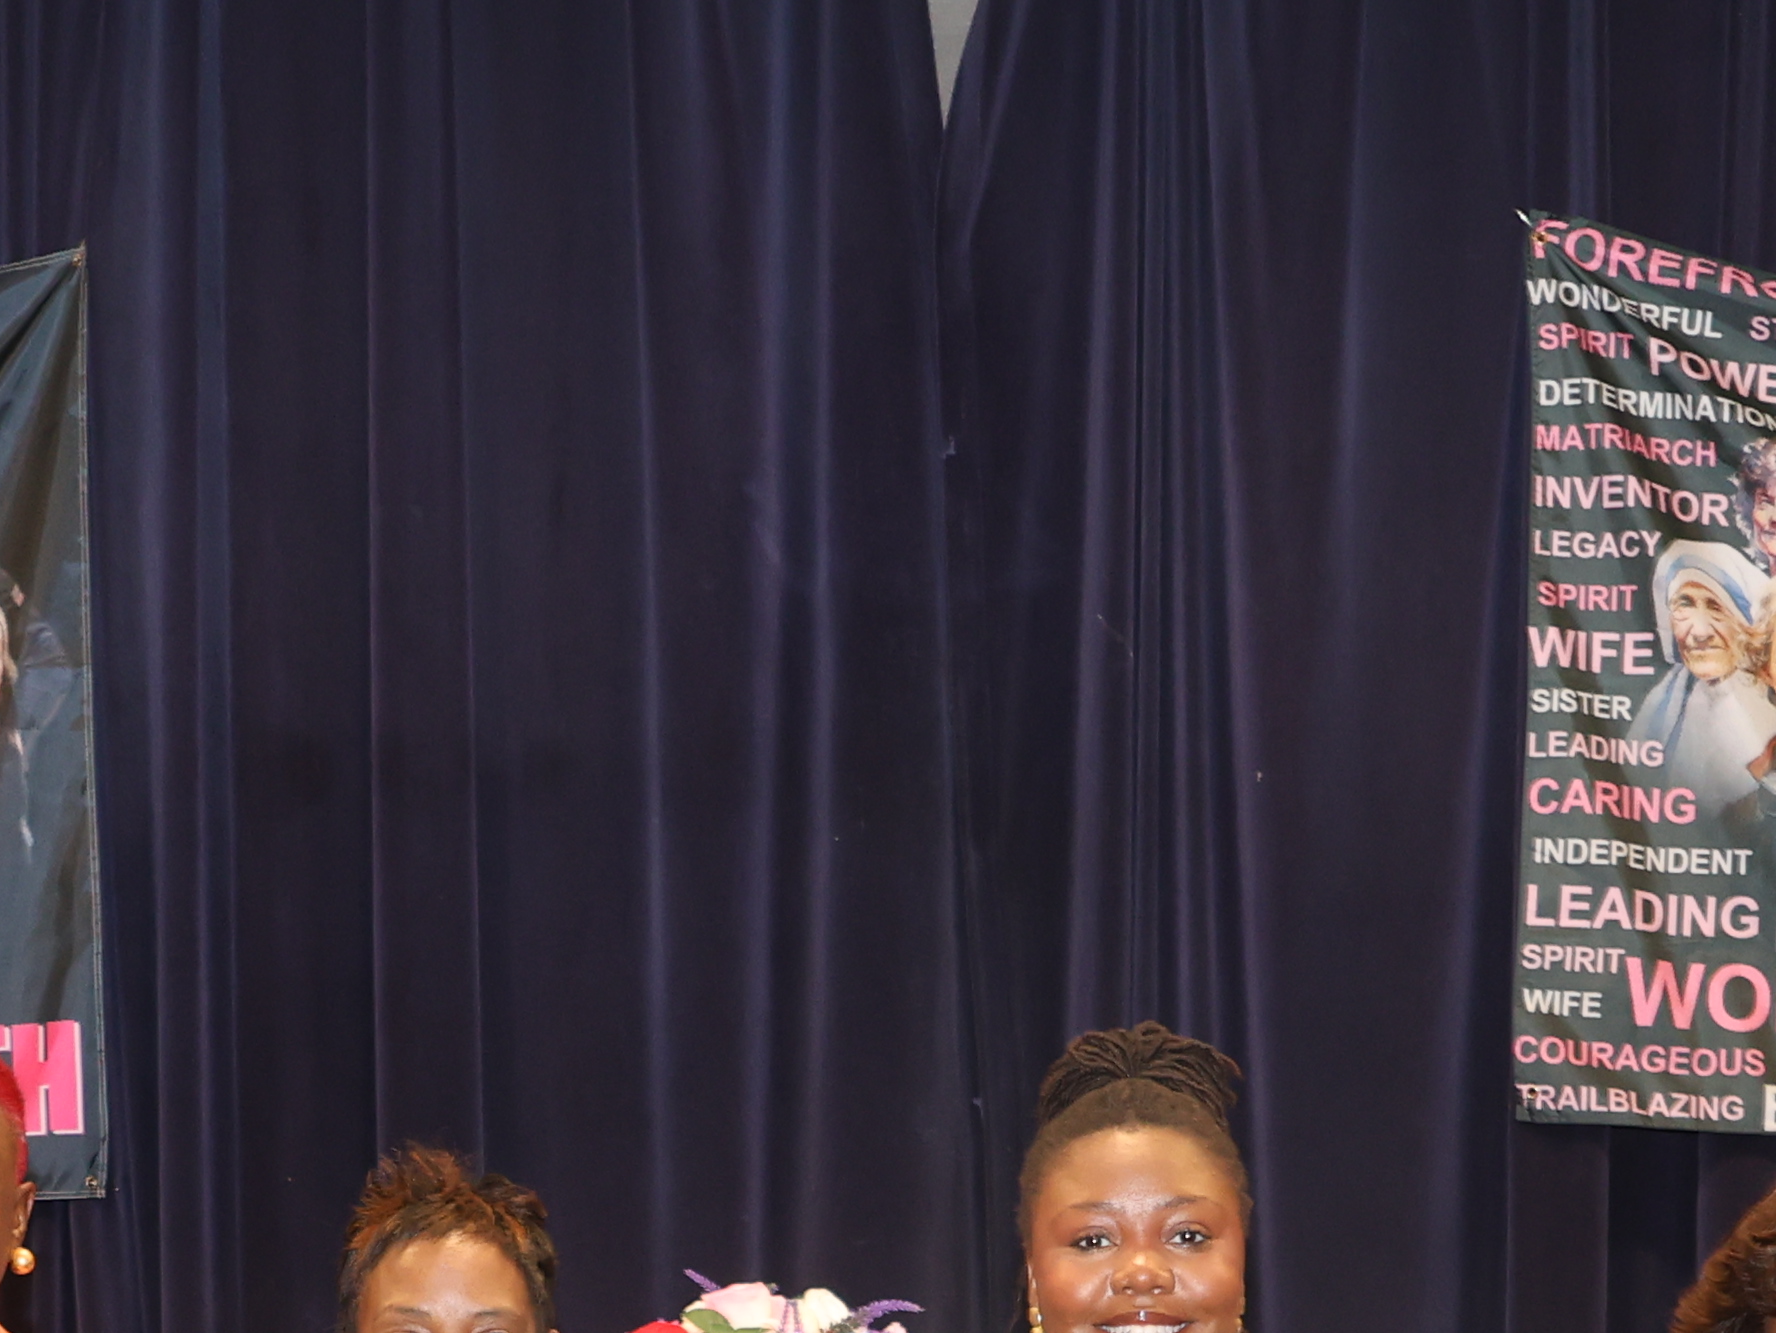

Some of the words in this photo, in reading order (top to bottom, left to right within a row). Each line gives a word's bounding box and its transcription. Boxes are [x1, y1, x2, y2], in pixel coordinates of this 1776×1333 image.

[1526, 278, 1723, 338] WONDERFUL
[1538, 322, 1634, 360] SPIRIT
[1534, 423, 1717, 467] MATRIARCH
[1534, 474, 1730, 527] INVENTOR
[1534, 530, 1662, 559] LEGACY
[1537, 581, 1638, 612] SPIRIT
[1527, 626, 1655, 675] WIFE
[1531, 688, 1632, 722] SISTER
[1528, 732, 1664, 767] LEADING
[1528, 779, 1698, 825] CARING
[1533, 837, 1753, 877] INDEPENDENT
[1524, 883, 1761, 940] LEADING
[1522, 944, 1626, 975] SPIRIT
[1523, 988, 1602, 1019] WIFE
[1513, 1035, 1766, 1078] COURAGEOUS
[1515, 1084, 1745, 1122] TRAILBLAZING
